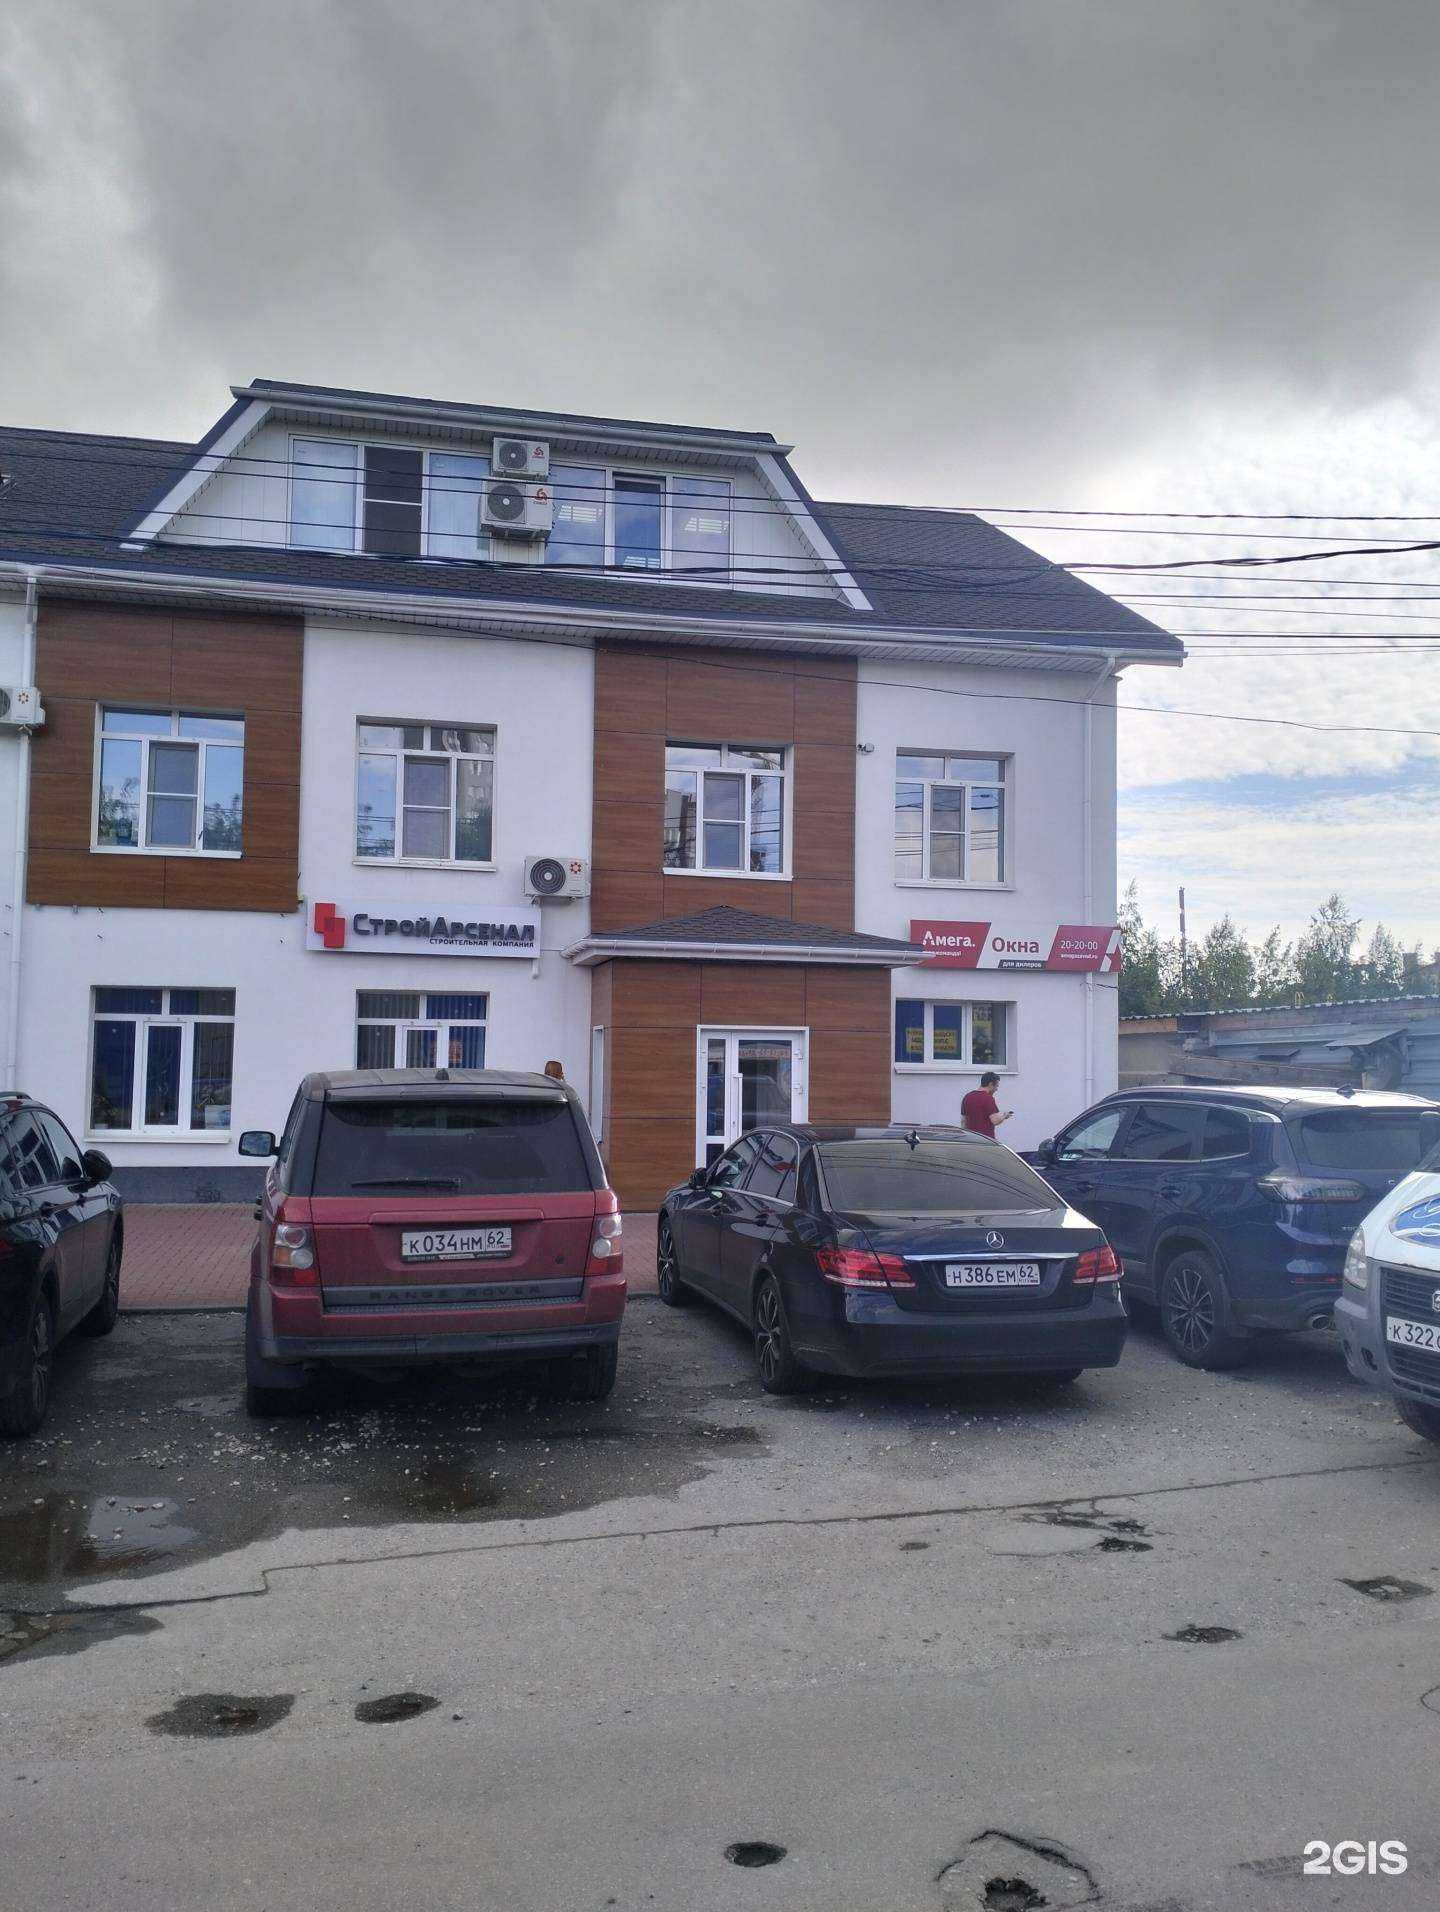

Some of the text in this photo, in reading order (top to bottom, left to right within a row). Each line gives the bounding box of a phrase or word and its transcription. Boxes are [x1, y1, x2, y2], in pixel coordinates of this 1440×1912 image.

[429, 937, 534, 948] СТРОИТЕЛЬНАЯ КОМПАНИЯ
[992, 937, 1040, 953] Окна
[1060, 940, 1098, 950] 20-20-00
[487, 1231, 504, 1246] 62
[1019, 1265, 1034, 1279] 62
[369, 1285, 541, 1300] RANGE ROVER
